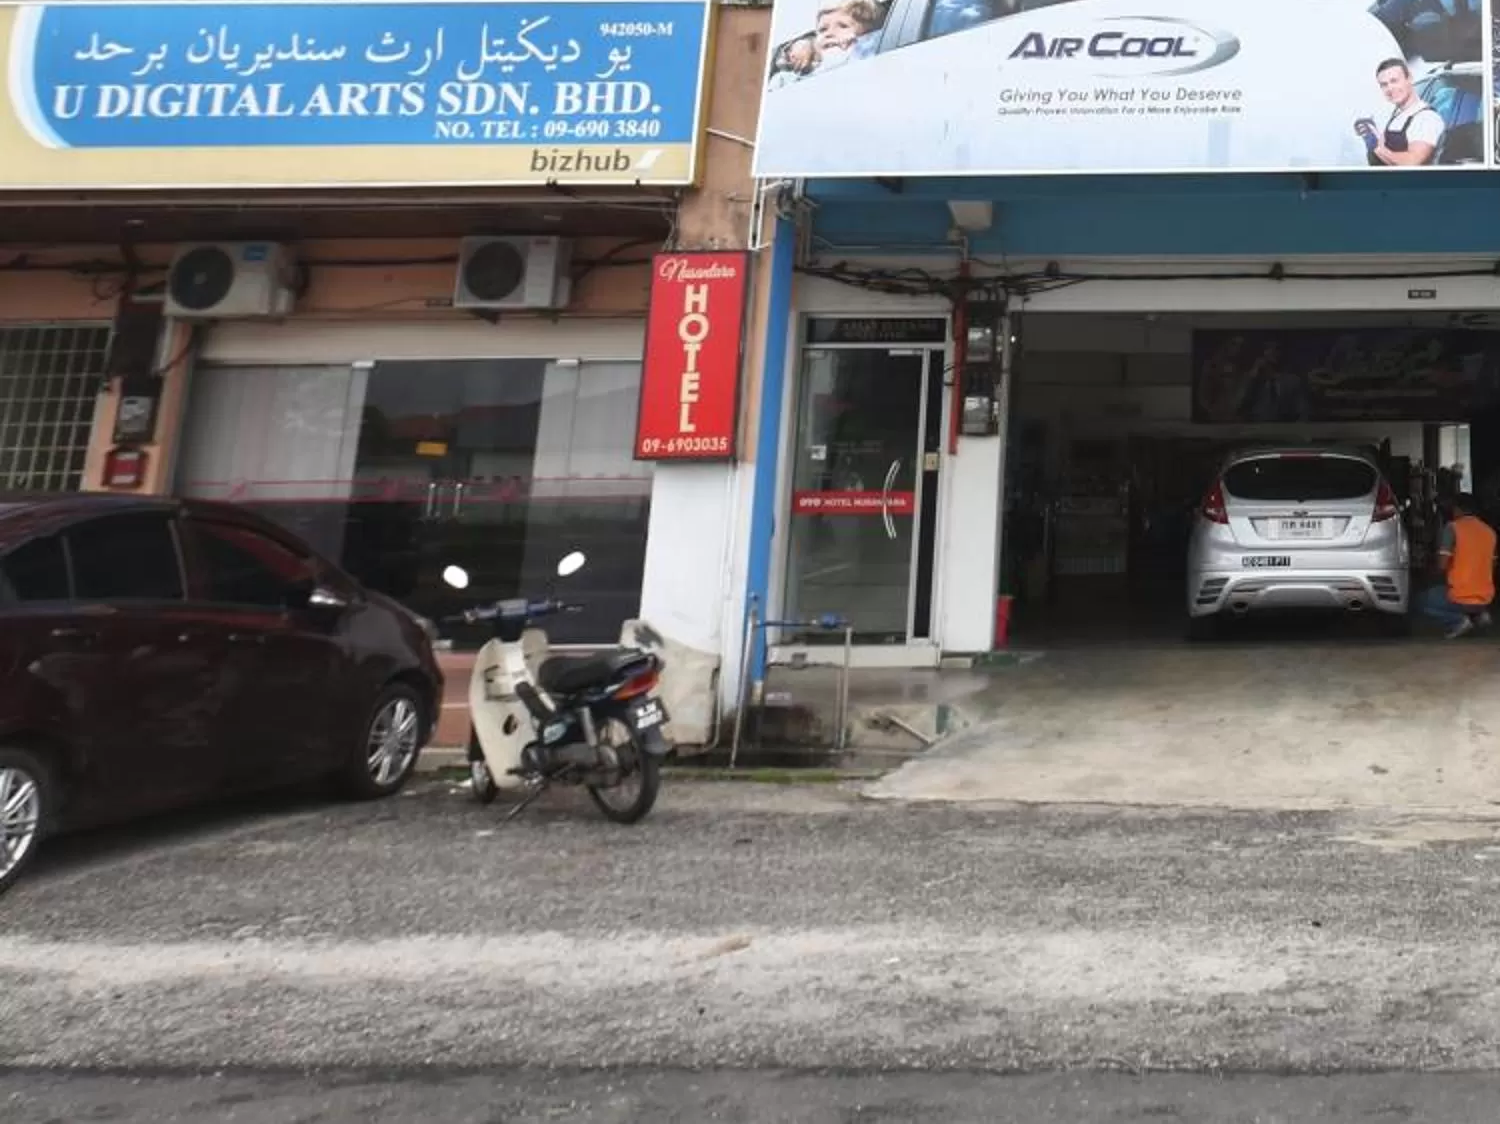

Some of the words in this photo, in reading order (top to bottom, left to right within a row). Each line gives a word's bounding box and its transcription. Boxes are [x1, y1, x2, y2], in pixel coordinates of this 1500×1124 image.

[600, 22, 673, 37] 942050-M
[595, 44, 632, 78] يو
[53, 84, 88, 119] U
[94, 83, 295, 118] DIGITAL
[301, 81, 425, 117] ARTS
[436, 81, 539, 116] SDN.
[553, 81, 661, 115] BHD.
[999, 87, 1053, 104] Giving
[1058, 87, 1089, 101] You
[1094, 86, 1134, 101] What
[1141, 87, 1171, 101] You
[1176, 87, 1242, 101] Deserve
[434, 121, 475, 139] NO.
[543, 120, 608, 138] 09-690
[613, 119, 660, 137] 3840
[530, 147, 631, 173] bizhub
[678, 284, 710, 433] HOTEL
[642, 437, 728, 453] 09-6903035
